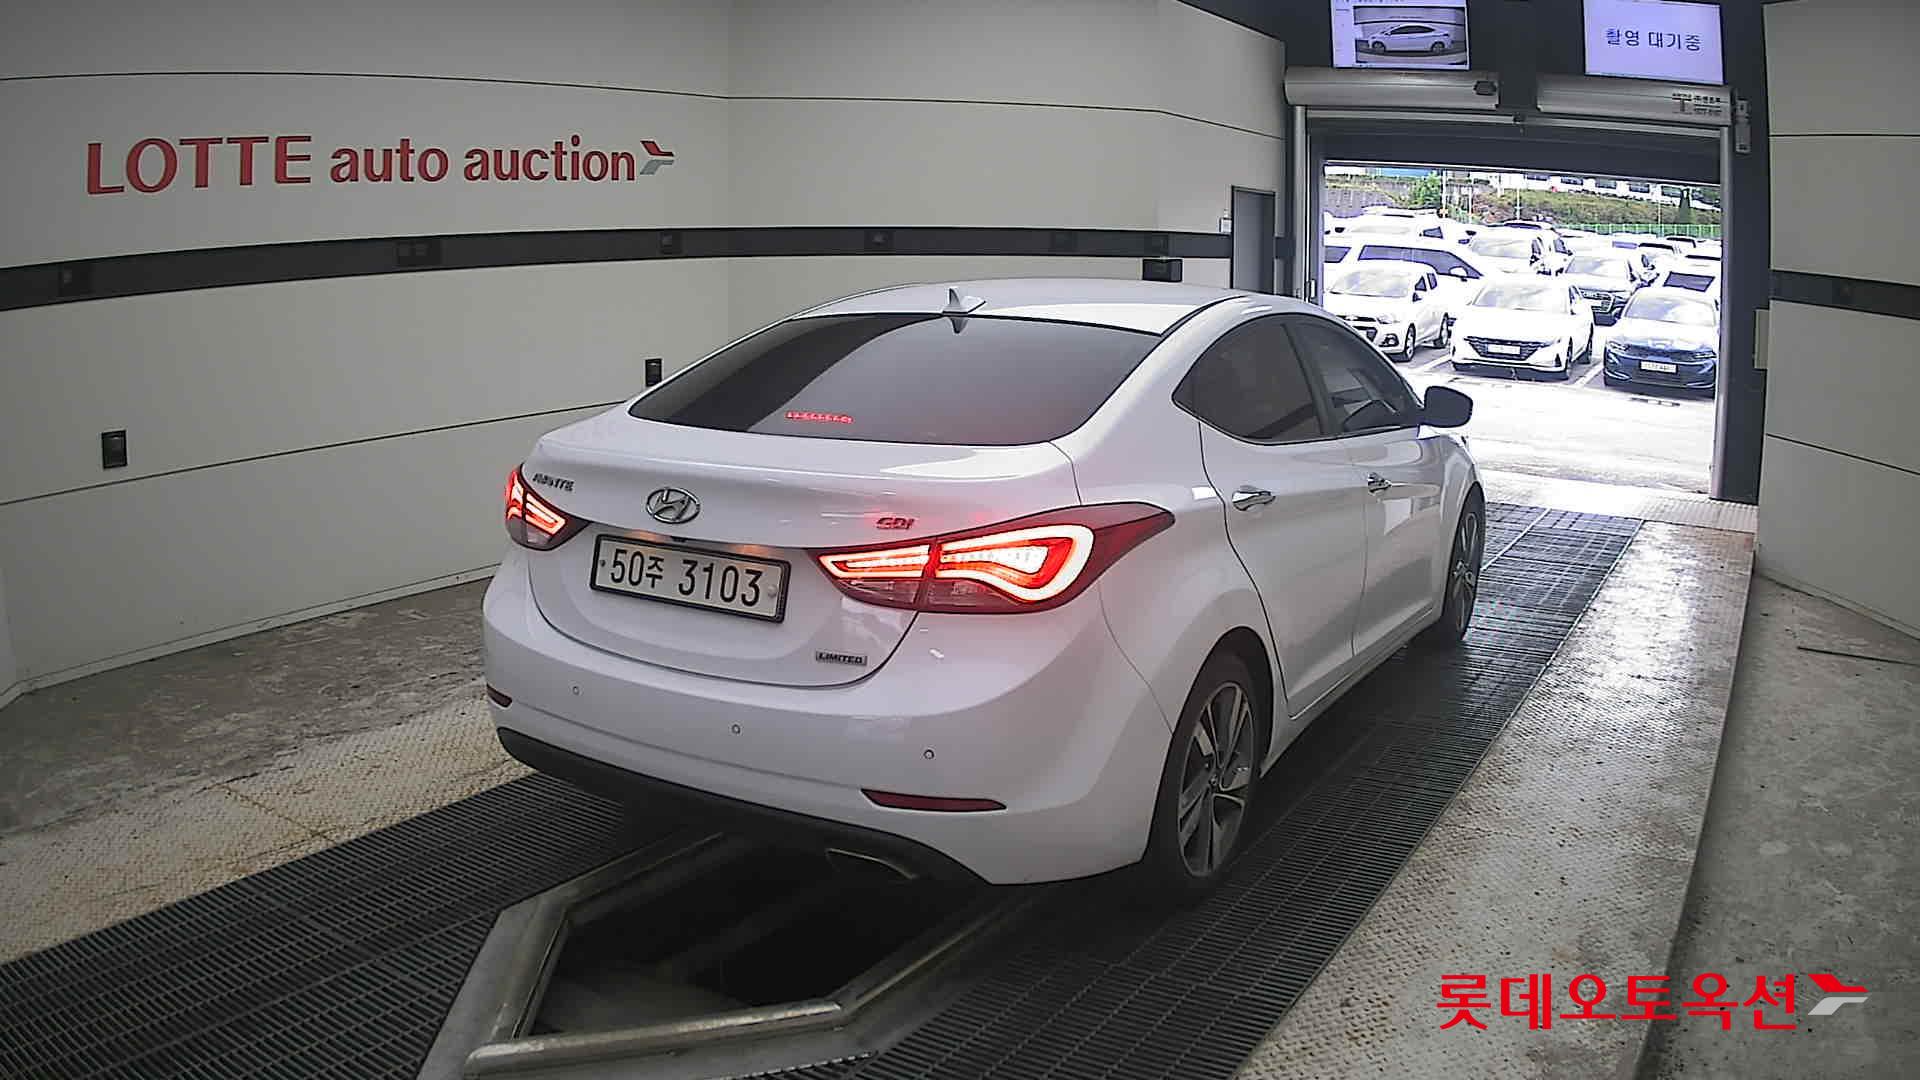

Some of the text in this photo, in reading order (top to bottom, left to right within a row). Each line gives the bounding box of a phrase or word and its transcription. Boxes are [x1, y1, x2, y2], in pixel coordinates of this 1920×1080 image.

[1607, 27, 1702, 52] 촬영 대기중
[87, 134, 635, 195] LOTTE auto auction
[611, 548, 764, 607] 50주 3103
[818, 651, 864, 664] LIMITED
